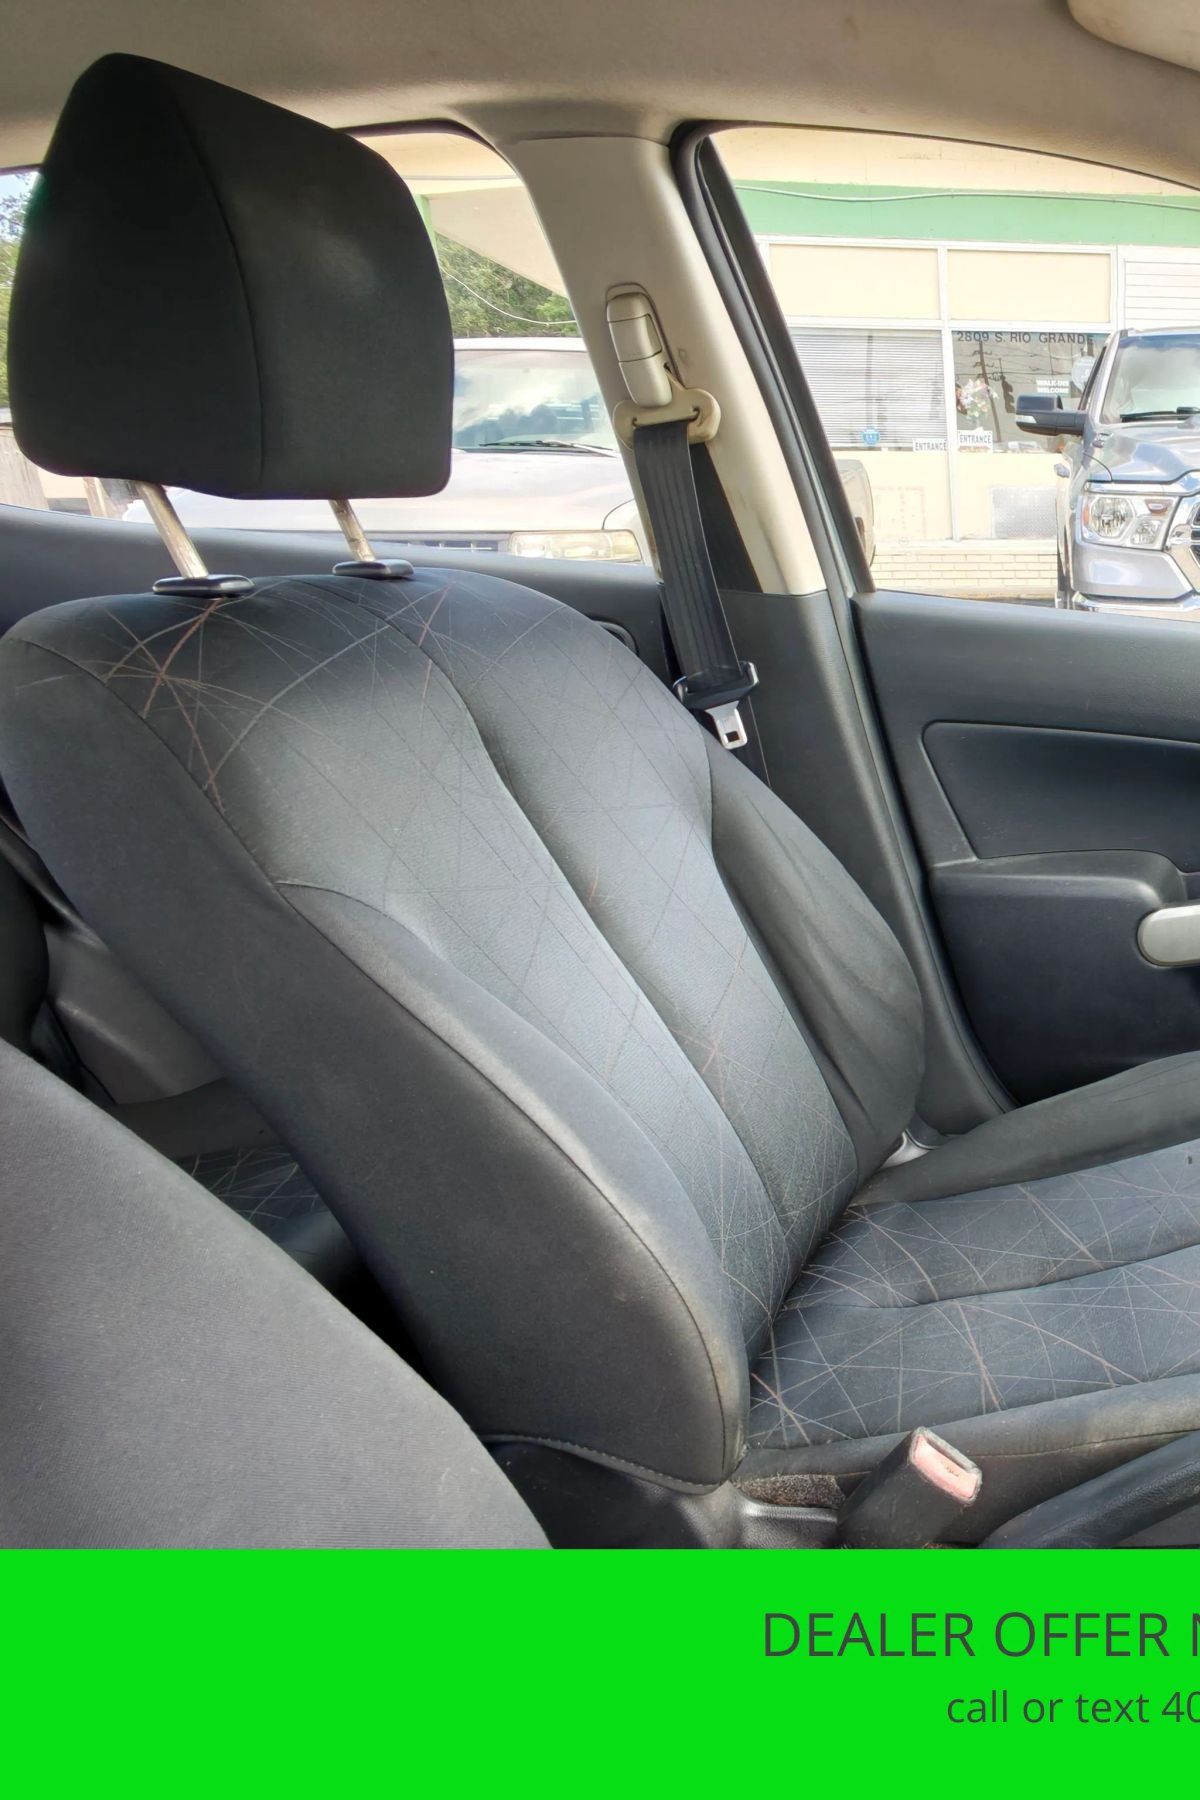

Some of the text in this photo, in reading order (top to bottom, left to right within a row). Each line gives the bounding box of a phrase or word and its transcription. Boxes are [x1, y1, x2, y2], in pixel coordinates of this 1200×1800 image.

[957, 331, 1094, 346] 2809 S. RIO GRANDE
[959, 433, 992, 445] ENTRANCE
[914, 441, 947, 452] ENTRANCE
